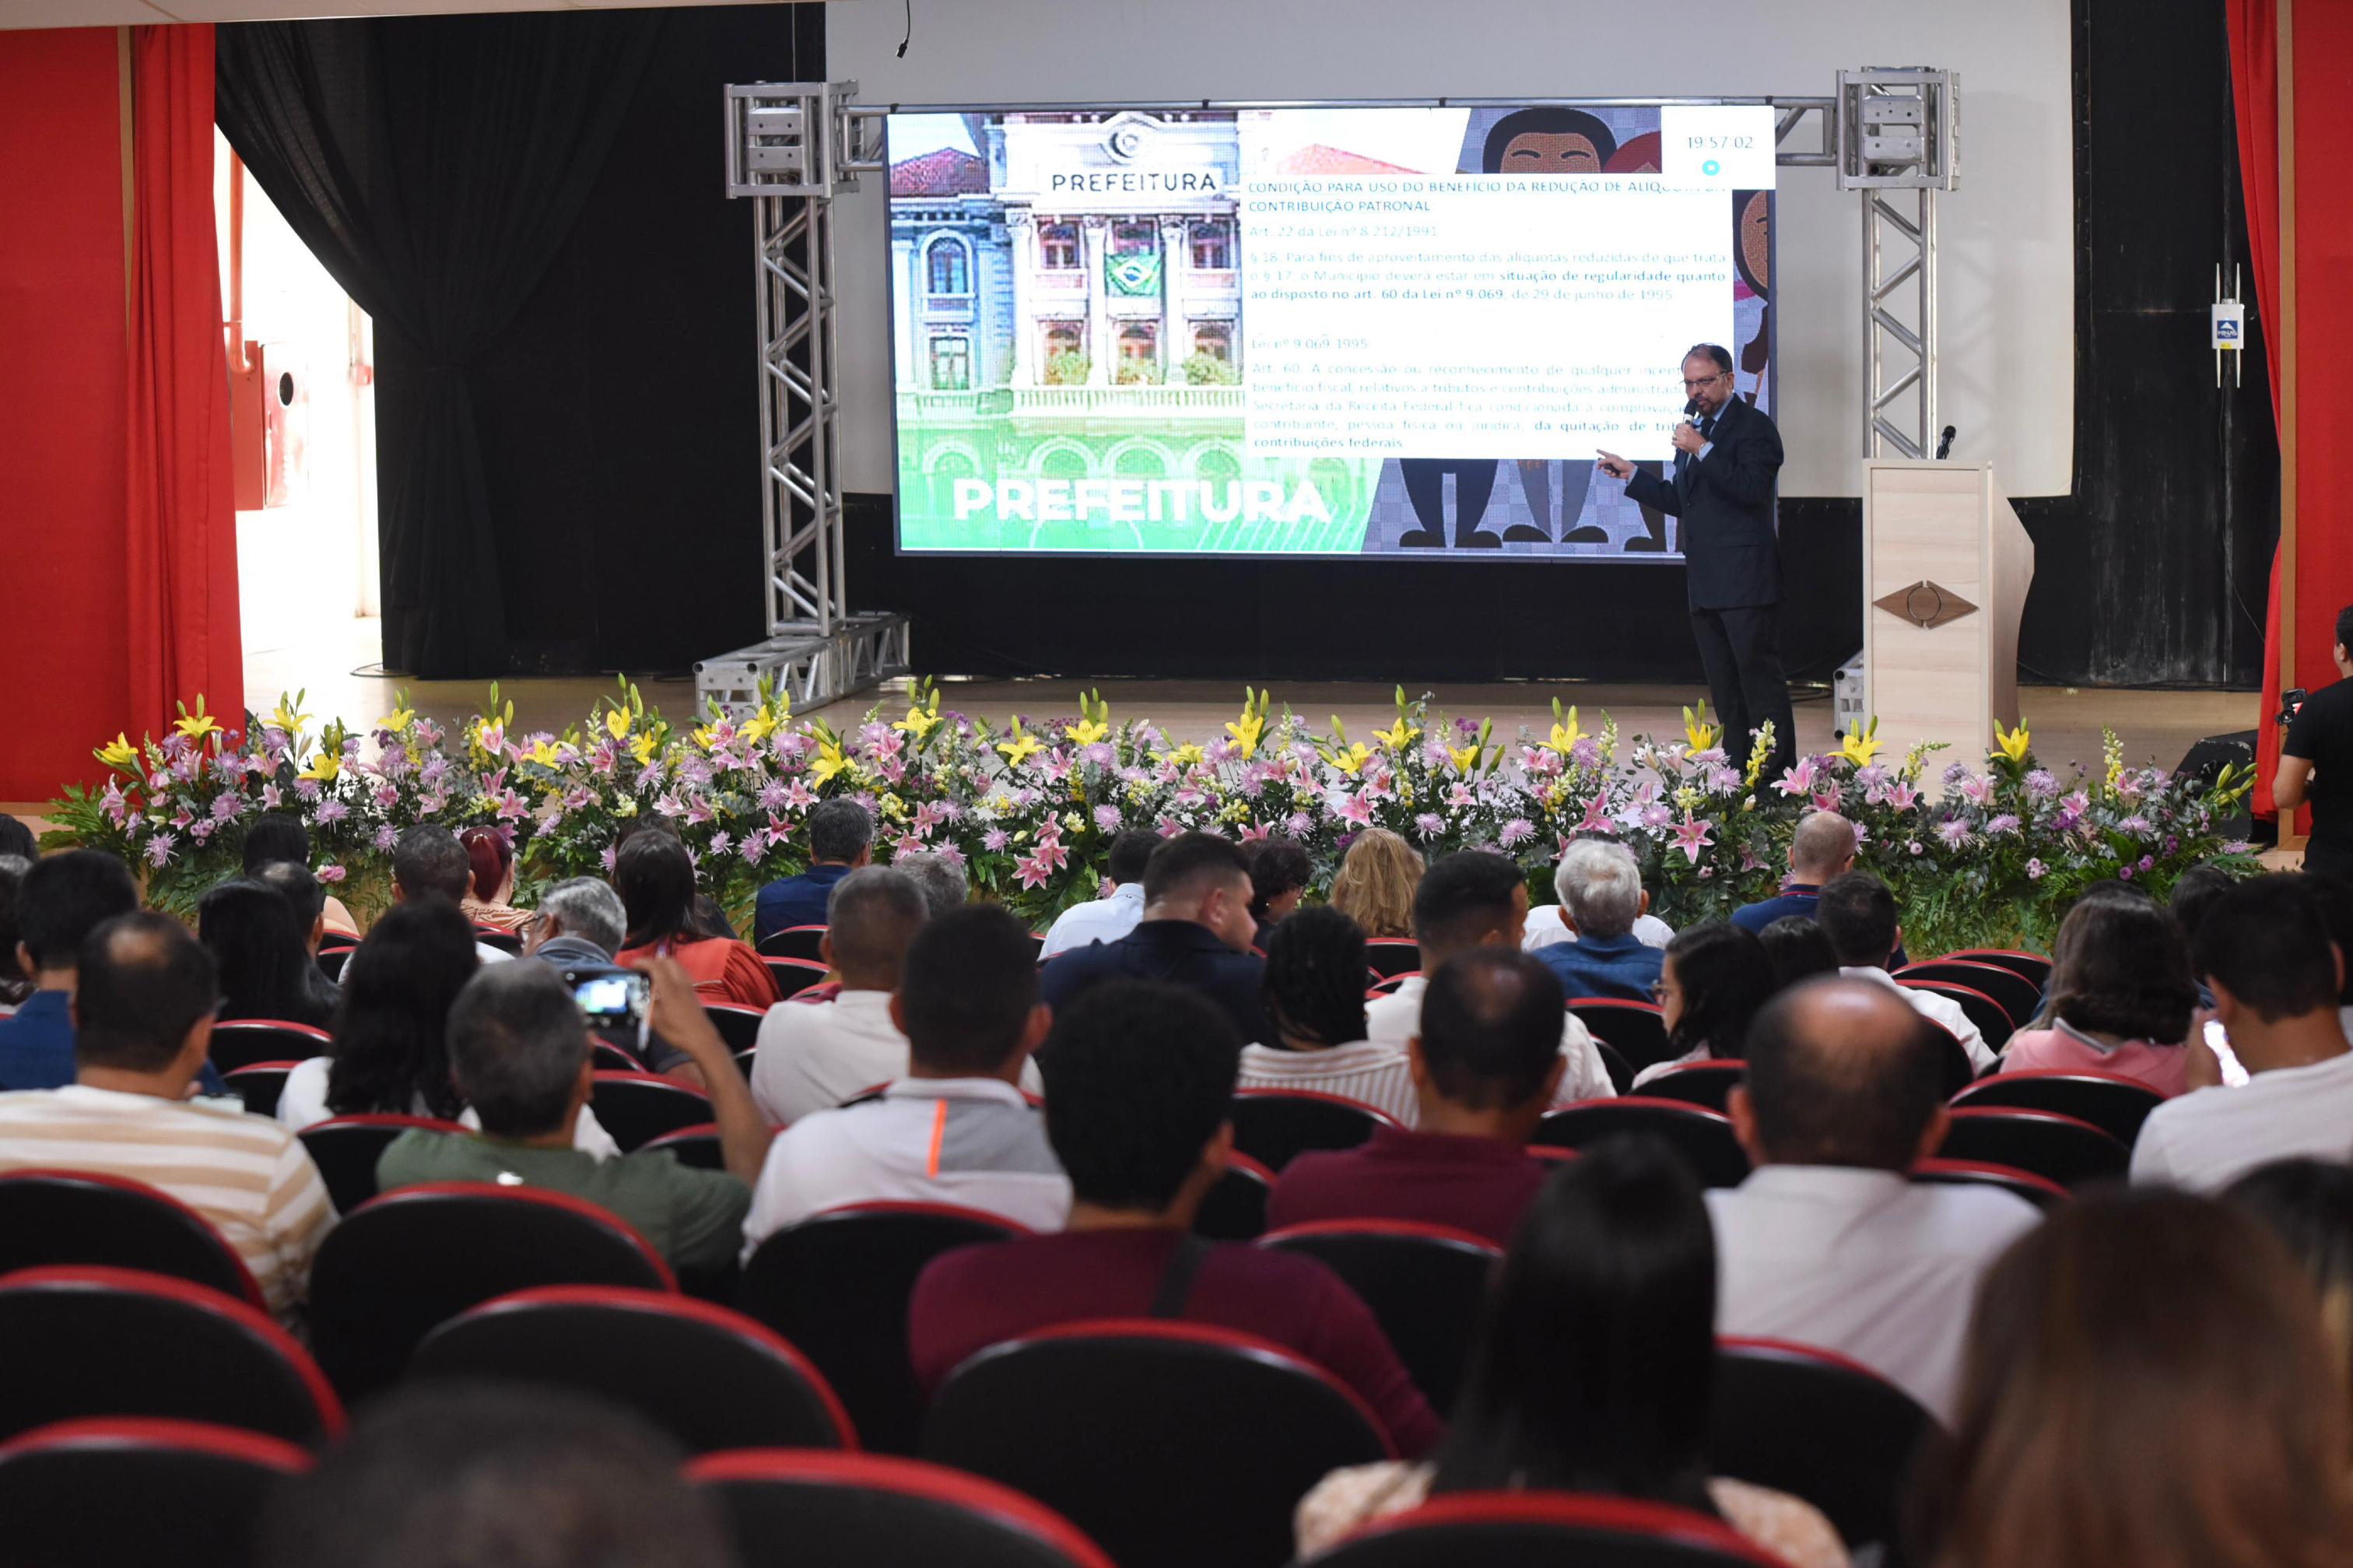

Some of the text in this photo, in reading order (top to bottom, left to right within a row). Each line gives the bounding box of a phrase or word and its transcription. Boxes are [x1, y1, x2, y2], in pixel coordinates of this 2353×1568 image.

[1688, 136, 1754, 149] 19:57:02
[1052, 173, 1216, 192] PREFEITURA
[1248, 180, 1323, 195] CONDIÇÃO
[1327, 182, 1363, 192] PARA
[1369, 182, 1397, 192] USO
[1403, 182, 1423, 192] DO
[1429, 180, 1502, 192] BENEFÍCIO
[1506, 182, 1527, 191] DA
[1531, 180, 1600, 195] REDUÇÃO
[1604, 182, 1622, 191] DE
[1248, 199, 1432, 214] CONTRIBUIÇÃO PATRONAL
[1278, 226, 1293, 237] 22
[1297, 226, 1315, 237] da
[1320, 226, 1337, 237] Lei
[1286, 252, 1316, 263] Para
[1319, 251, 1344, 263] fins
[1347, 251, 1365, 263] de
[1367, 252, 1475, 265] aproveitamento
[1479, 251, 1503, 263] das
[1572, 251, 1638, 263] reduzidas
[1641, 251, 1660, 263] de
[1663, 253, 1689, 265] que
[1692, 252, 1727, 263] trata
[1250, 272, 1258, 282] o
[1300, 272, 1310, 281] o
[1436, 271, 1468, 281] estar
[1473, 272, 1496, 281] em
[1499, 269, 1558, 284] situação
[1562, 270, 1580, 282] de
[1583, 269, 1672, 284] regularidade
[1675, 271, 1727, 284] quanto
[1250, 291, 1268, 300] ao
[1270, 288, 1329, 302] disposto
[1353, 289, 1377, 300] art.
[1381, 288, 1398, 300] 60
[1401, 288, 1418, 299] da
[1422, 288, 1441, 299] Lei
[1445, 288, 1462, 299] nº
[1511, 288, 1530, 300] de
[1533, 289, 1550, 300] 29
[1552, 288, 1571, 300] de
[1574, 288, 1615, 302] junho
[1618, 288, 1636, 300] de
[1312, 363, 1321, 374] A
[1327, 363, 1398, 374] concessão
[1404, 366, 1422, 374] ou
[1429, 363, 1540, 375] reconhecimento
[1546, 363, 1564, 375] de
[1570, 364, 1632, 377] qualquer
[1359, 381, 1418, 393] relativos
[1421, 384, 1429, 393] a
[1432, 381, 1487, 393] tributos
[1253, 398, 1320, 412] Secretaria
[1325, 399, 1343, 412] da
[1348, 399, 1397, 412] Receita
[1403, 399, 1453, 412] Federal
[1489, 400, 1580, 412] condicionada
[1347, 421, 1395, 434] pessoa
[1445, 422, 1464, 431] ou
[1534, 419, 1552, 431] da
[1559, 419, 1620, 435] quitação
[1629, 419, 1647, 431] de
[1254, 436, 1345, 451] contribuições
[953, 477, 1333, 524] PREFEITURA
